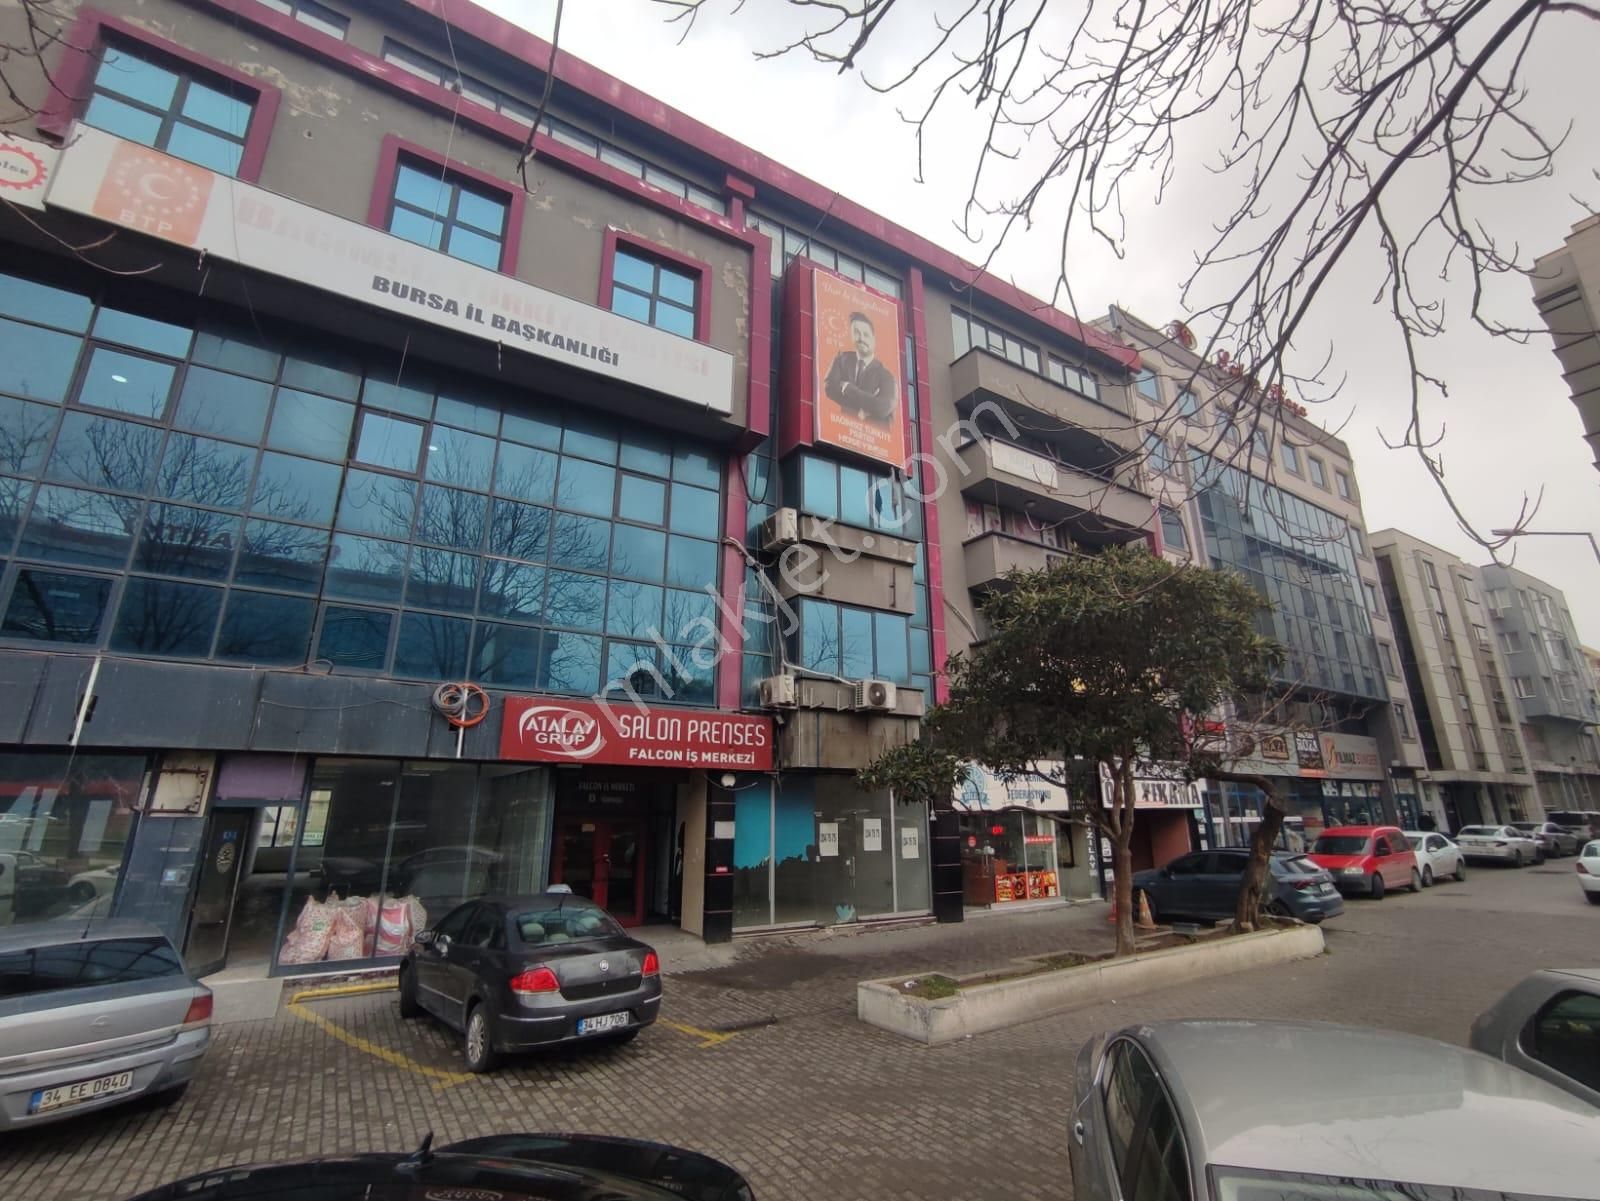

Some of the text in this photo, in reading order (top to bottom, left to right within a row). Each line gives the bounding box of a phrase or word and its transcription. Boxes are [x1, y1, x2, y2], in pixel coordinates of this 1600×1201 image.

[119, 210, 174, 233] BTP
[371, 275, 459, 317] BURSA
[465, 303, 486, 327] İL
[491, 314, 620, 367] BAŞKANLIĞI
[526, 714, 597, 734] ATALAY
[619, 714, 766, 747] SALON PRENSES
[535, 732, 586, 746] GRUP
[629, 747, 756, 765] FALCON İŞ MERKEZİ
[583, 1019, 594, 1031] 34
[42, 1074, 130, 1106] 34 EE 0840
